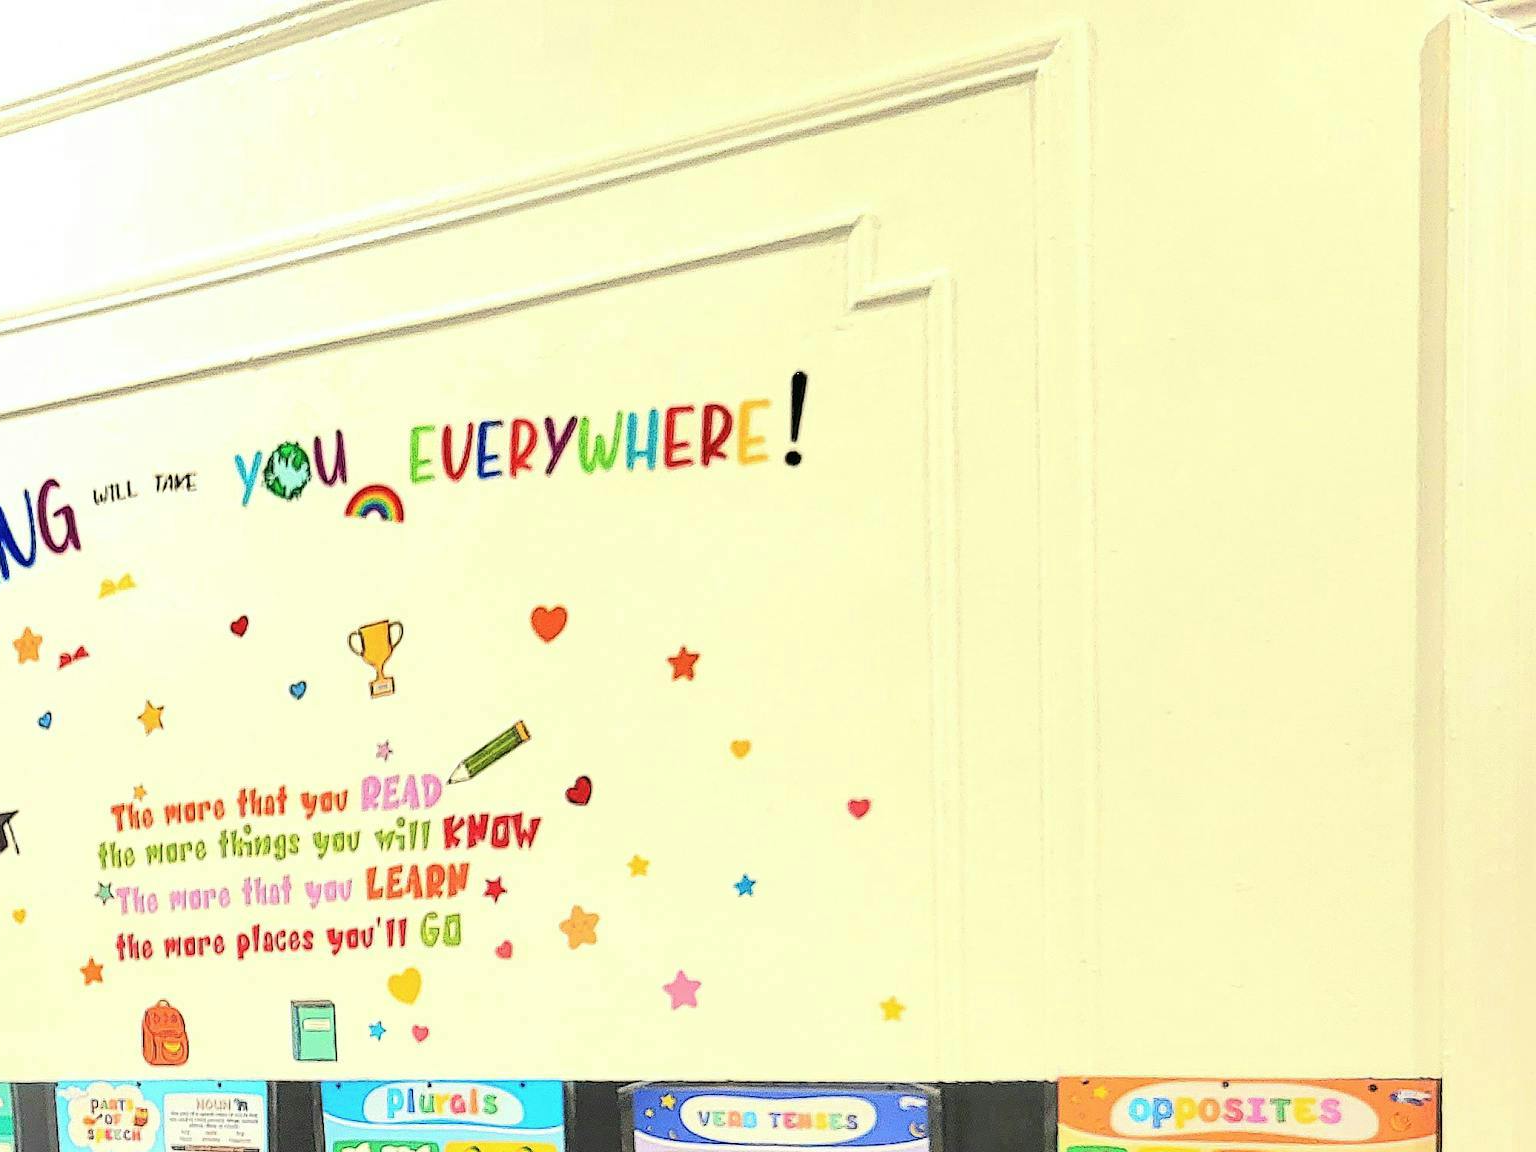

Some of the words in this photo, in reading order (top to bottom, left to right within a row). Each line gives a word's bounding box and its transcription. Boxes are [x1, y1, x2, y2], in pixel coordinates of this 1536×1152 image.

[92, 481, 139, 506] WILL
[111, 802, 154, 832] The
[164, 799, 225, 826] more
[237, 785, 287, 818] that
[300, 789, 348, 820] you
[361, 774, 443, 811] READ
[98, 841, 136, 869] the
[145, 839, 207, 866] more
[218, 823, 300, 861] things
[313, 830, 360, 860] you
[374, 816, 431, 851] will
[443, 812, 541, 850] KNOW
[116, 886, 158, 915] The
[169, 887, 231, 911] more
[242, 874, 292, 906] that
[305, 878, 353, 909] you
[366, 862, 470, 901] LEARN
[115, 932, 154, 961] the
[163, 934, 225, 958] more
[236, 923, 314, 960] places
[326, 915, 407, 956] you'll
[420, 911, 461, 947] GO
[1128, 1096, 1343, 1130] OPPOSITES
